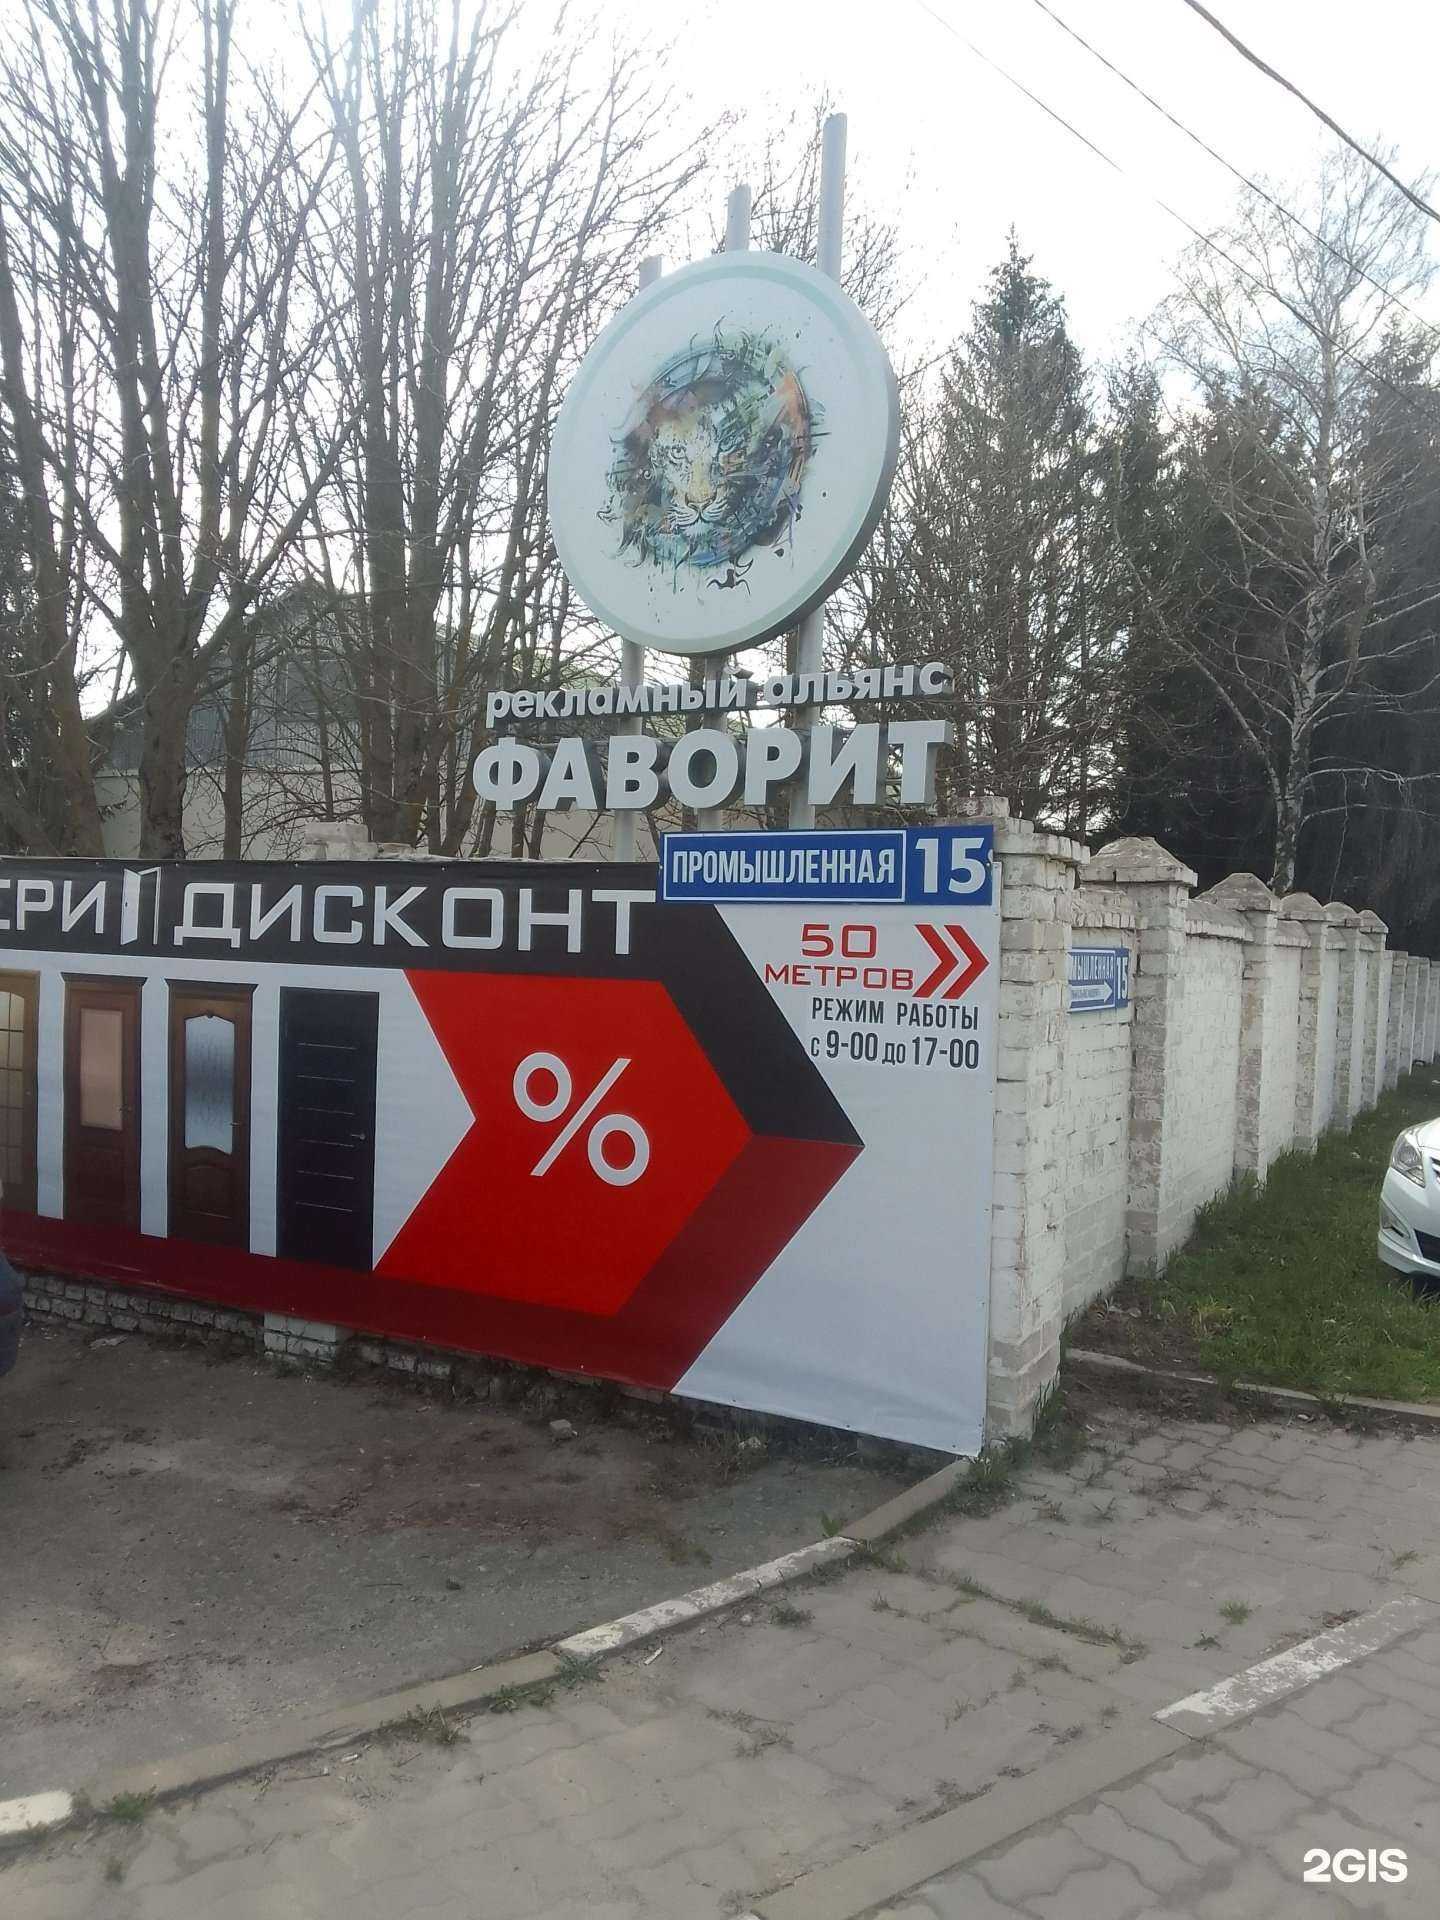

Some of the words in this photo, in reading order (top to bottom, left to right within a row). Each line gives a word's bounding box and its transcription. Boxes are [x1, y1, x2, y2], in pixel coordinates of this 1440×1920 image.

[486, 669, 750, 728] рекламный
[764, 661, 953, 705] альянс
[472, 719, 953, 812] ФАВОРИТ
[671, 848, 896, 884] ПРОМЫШЛЕННАЯ
[915, 837, 986, 894] 15
[173, 882, 656, 955] ДИСКОНТ
[800, 923, 878, 958] 50
[764, 963, 915, 991] МЕТРОВ
[1116, 956, 1129, 1000] 15
[811, 996, 885, 1025] РЕЖИМ
[896, 1001, 979, 1030] РАБОТЫ
[825, 1029, 878, 1062] 9-00
[882, 1041, 906, 1066] до
[911, 1035, 980, 1070] 17-00
[513, 1051, 650, 1187] %
